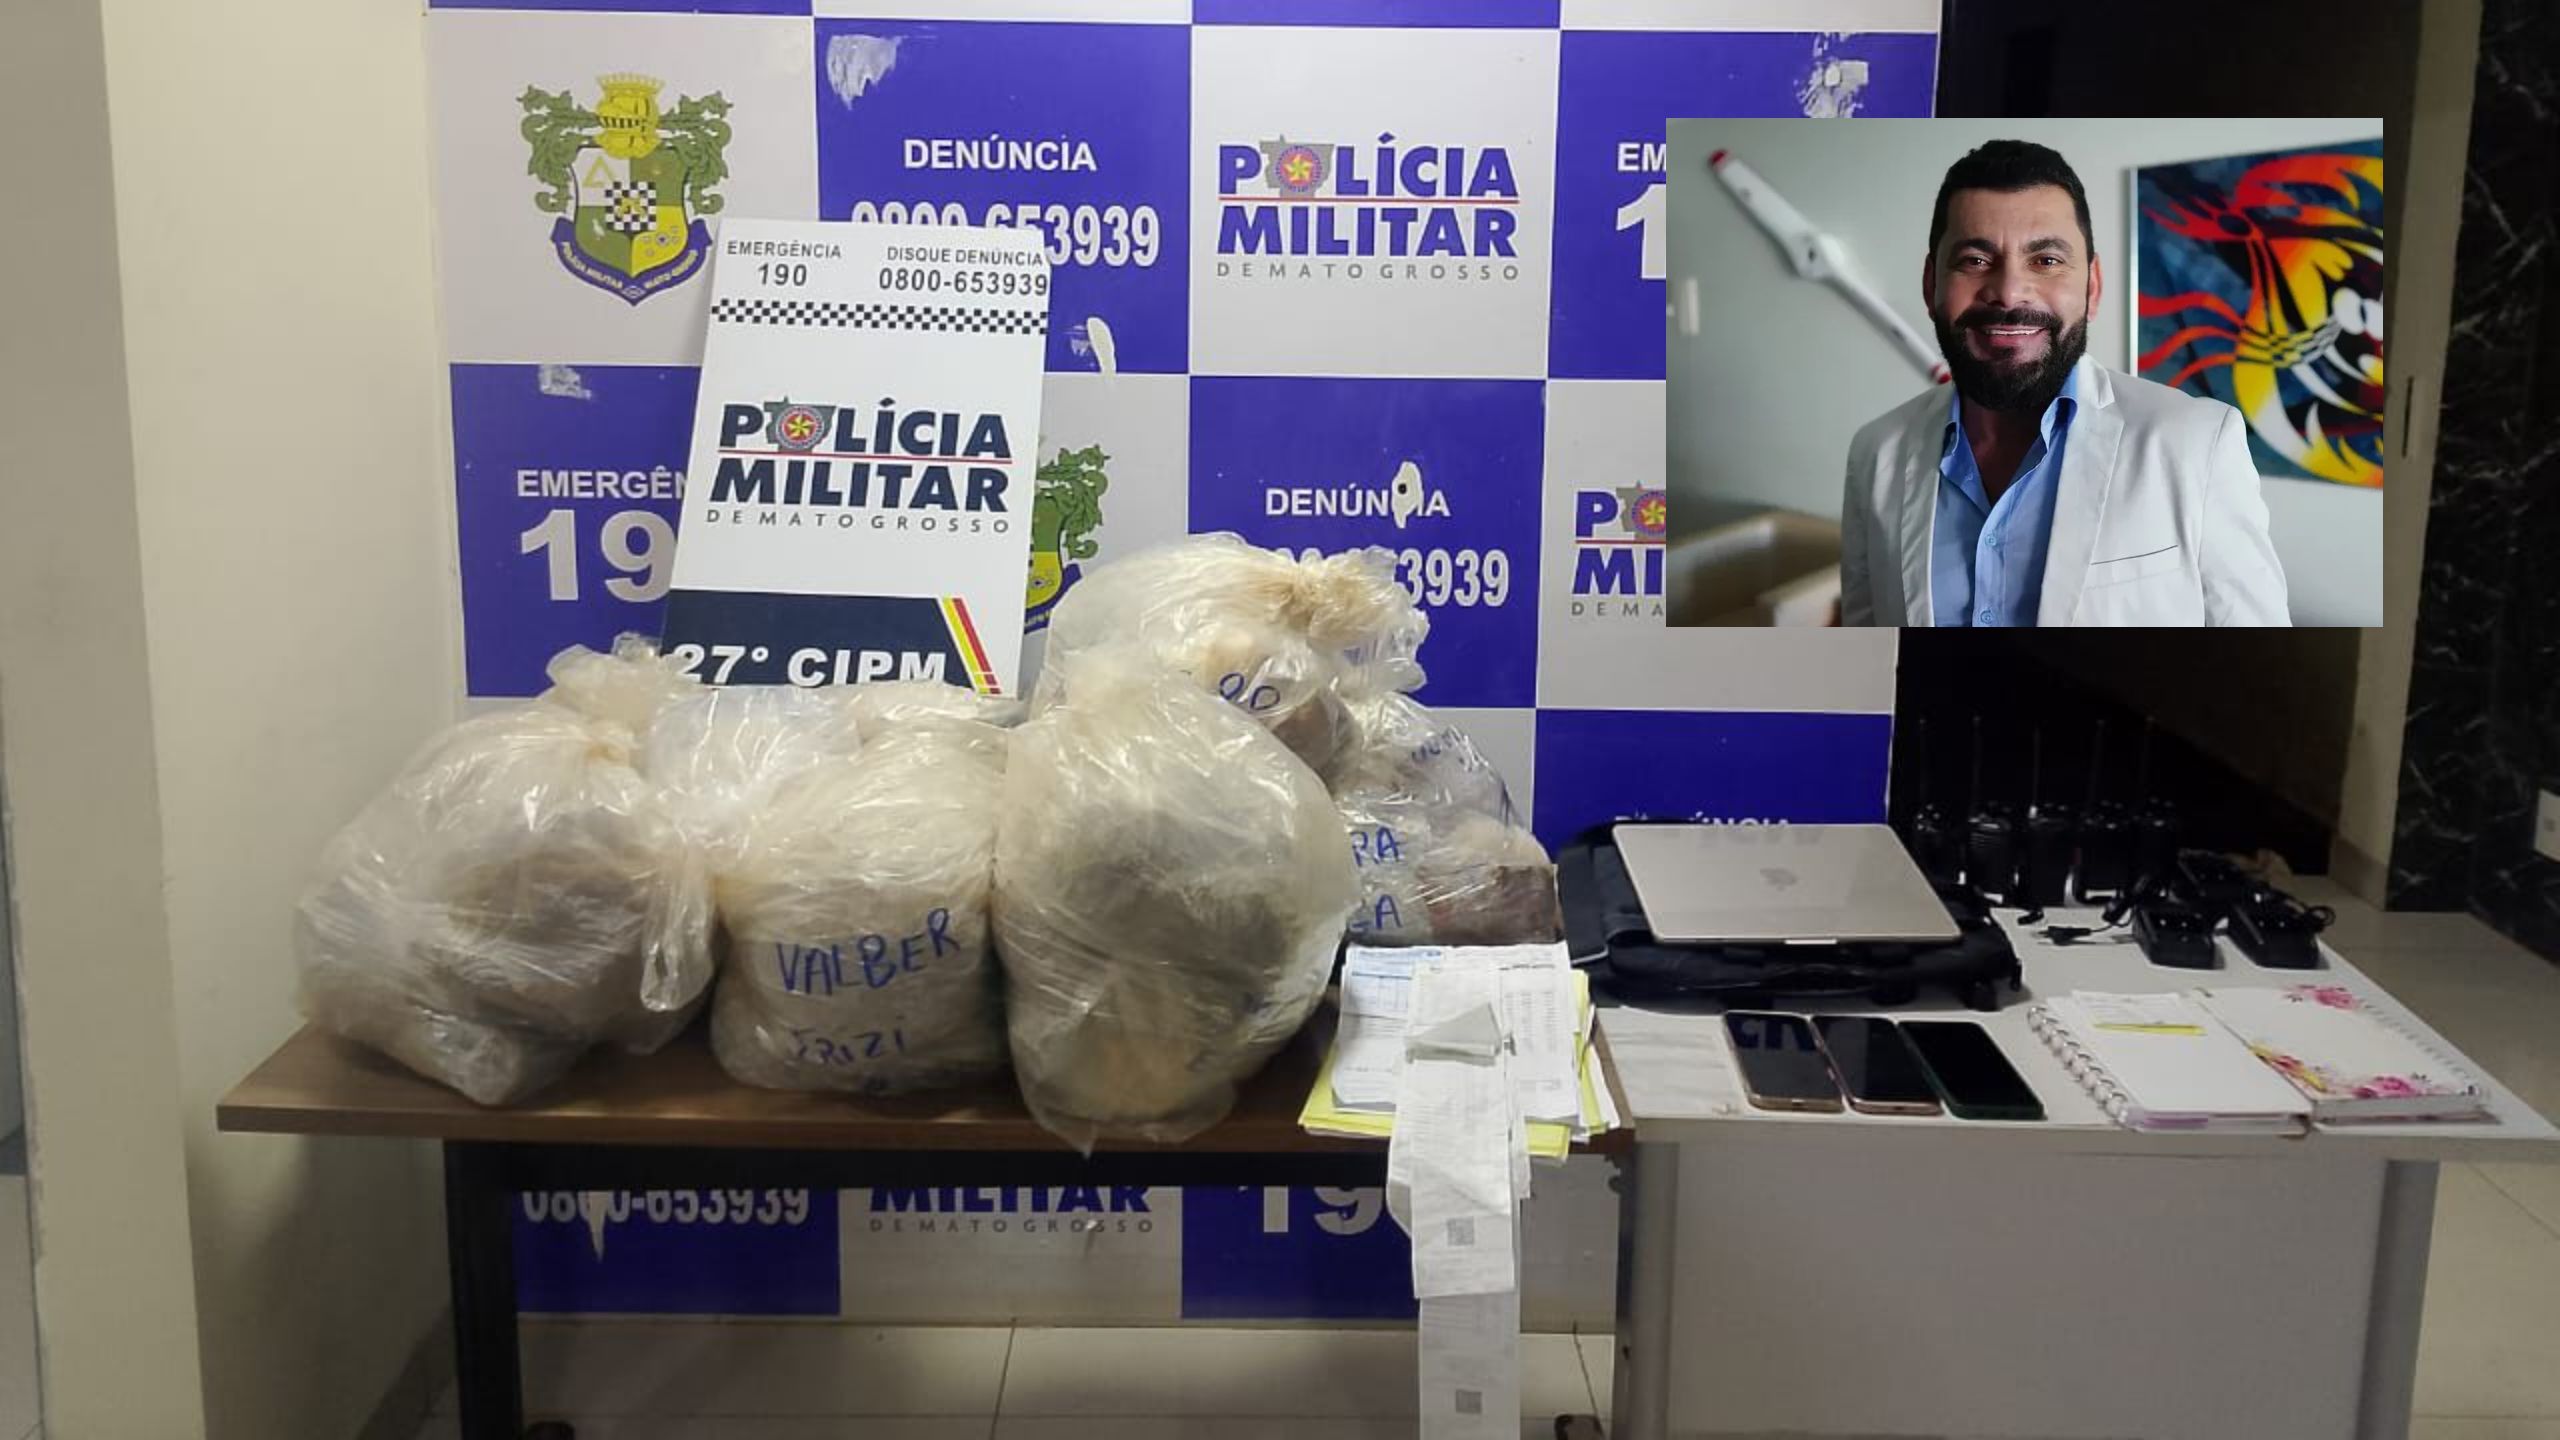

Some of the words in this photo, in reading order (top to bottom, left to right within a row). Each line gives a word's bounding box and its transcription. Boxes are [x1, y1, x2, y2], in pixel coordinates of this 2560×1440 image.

[904, 134, 1097, 171] DENÚNCIA
[727, 239, 841, 259] EMERGÊNCIA
[1217, 206, 1518, 257] MILITAR
[757, 263, 808, 286] 190
[887, 246, 950, 264] DISQUE
[955, 247, 1043, 266] DENÚNCIA
[879, 267, 1048, 296] 0800-653939
[709, 458, 1009, 512] MILITAR
[787, 648, 946, 687] CIPM
[776, 908, 961, 995] VALBER
